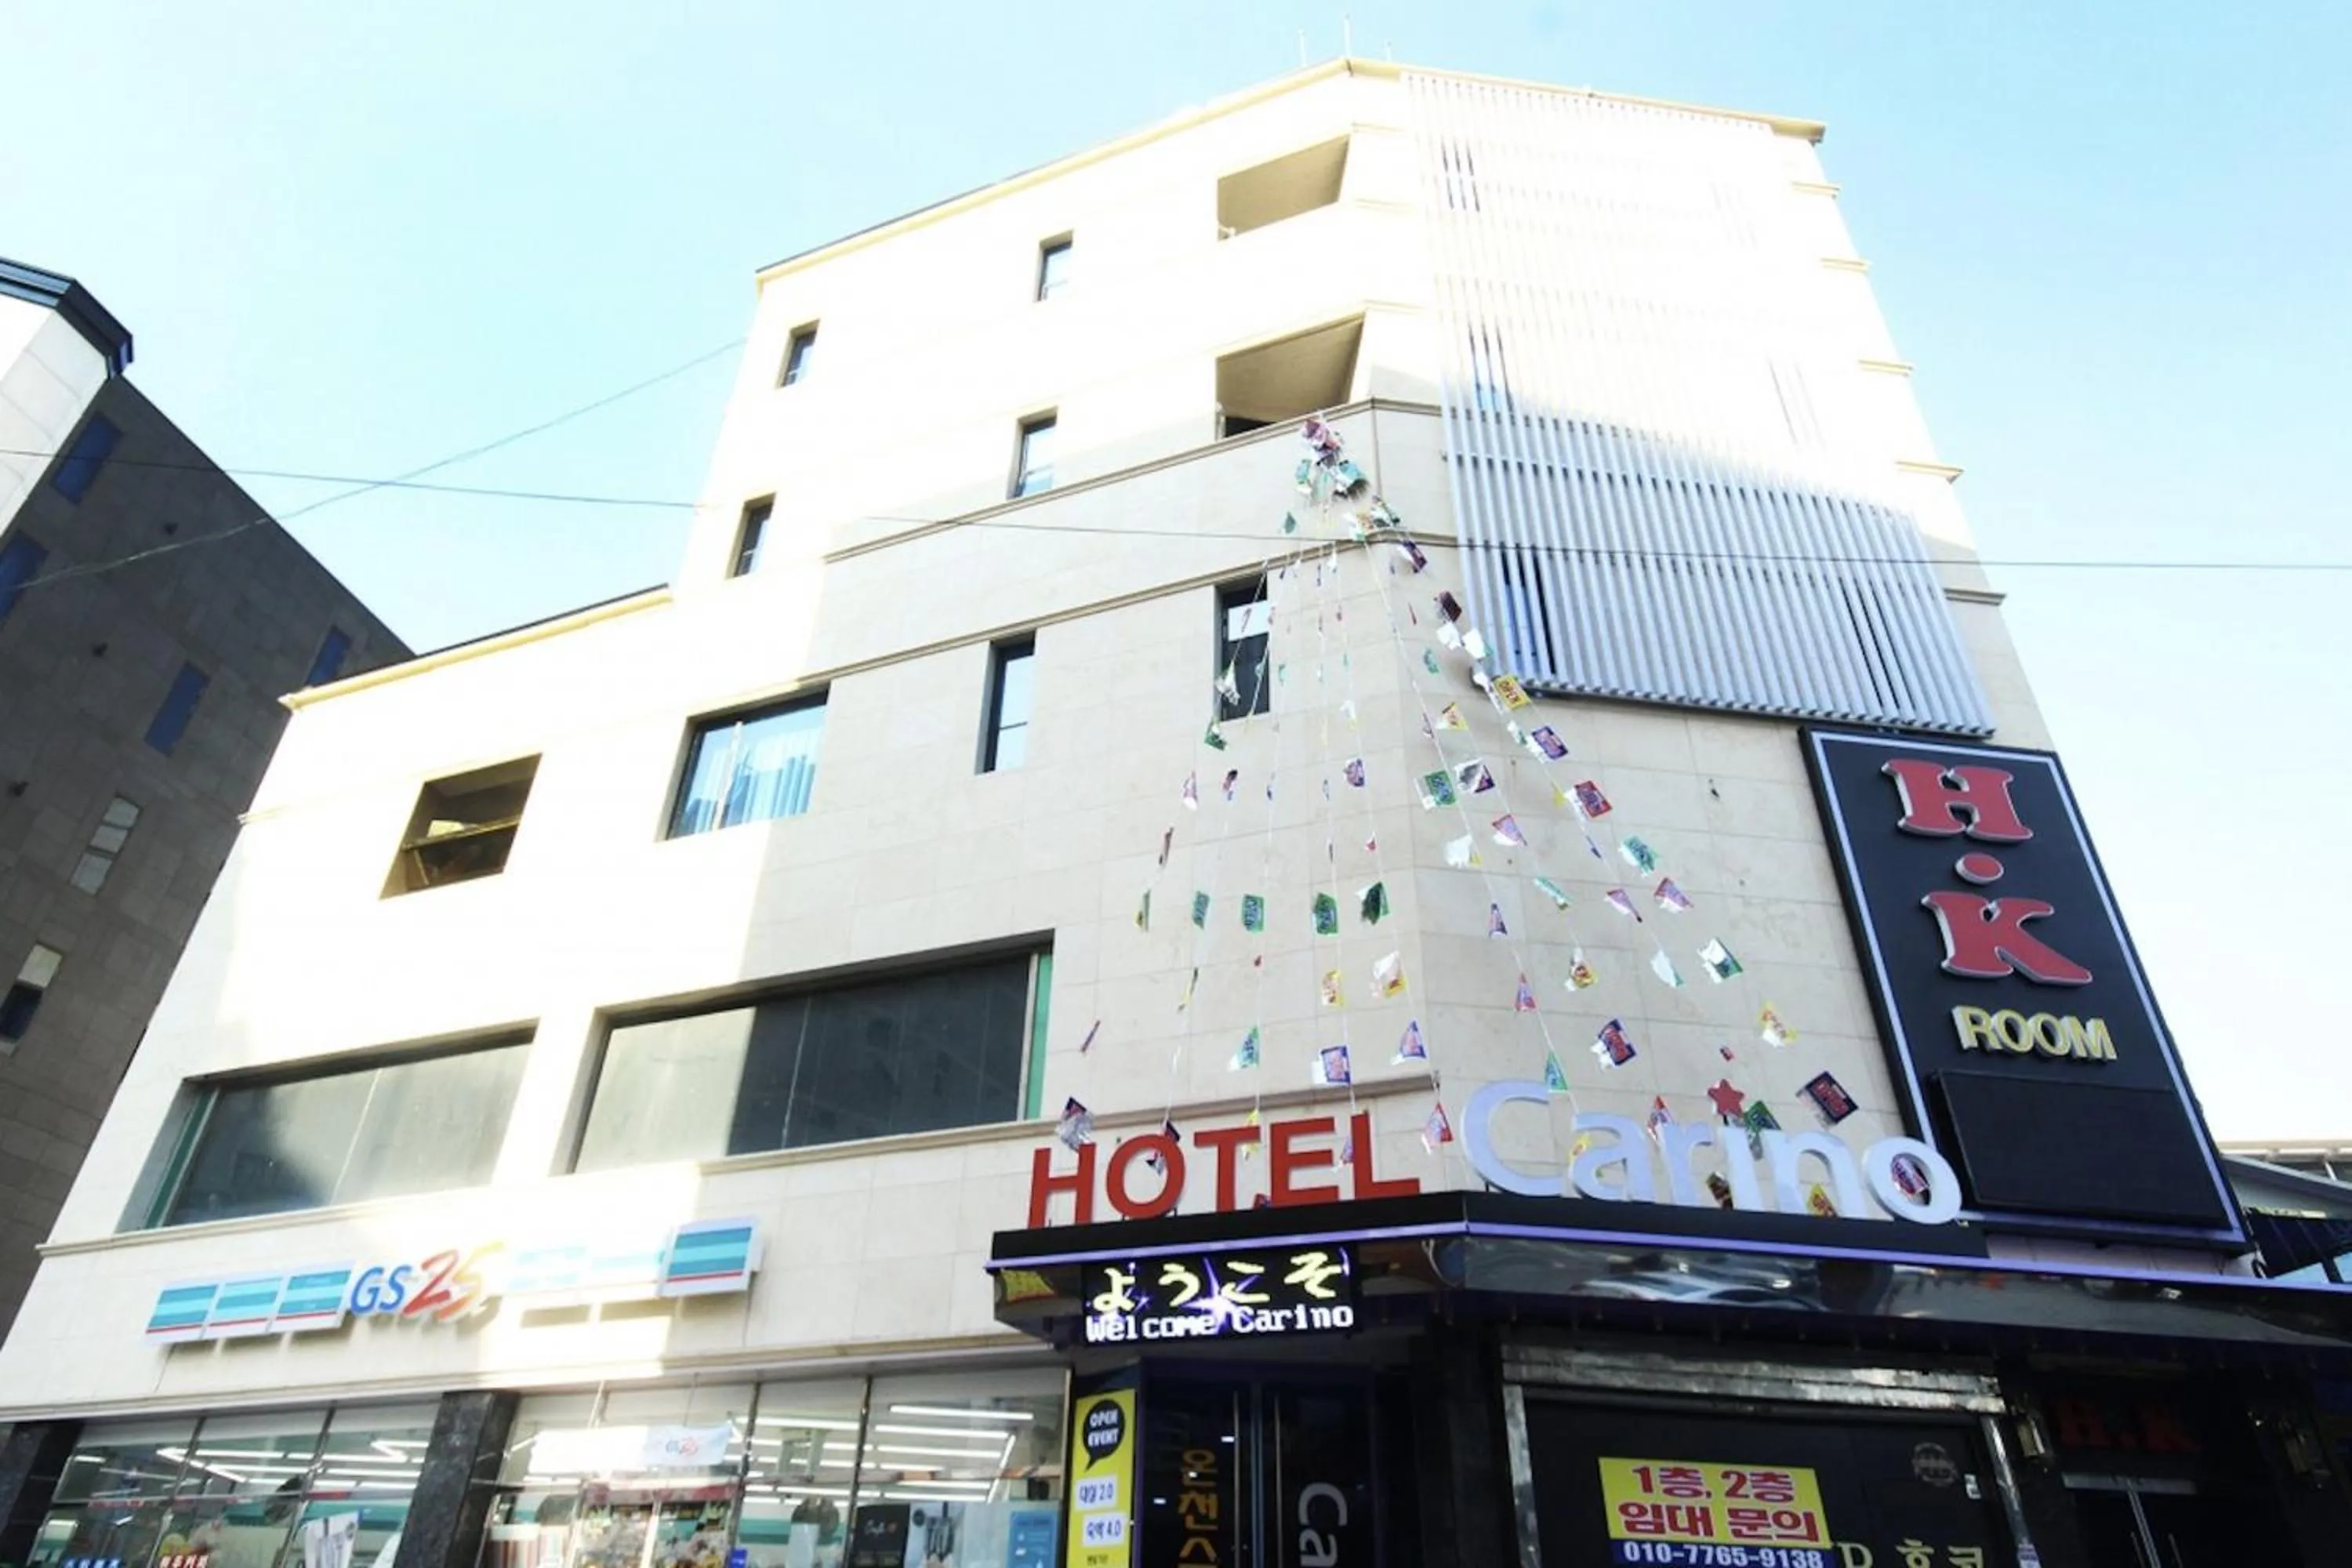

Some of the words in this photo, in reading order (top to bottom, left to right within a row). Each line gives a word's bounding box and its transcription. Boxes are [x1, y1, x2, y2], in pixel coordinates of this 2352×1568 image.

[1951, 1005, 2118, 1062] ROOM
[1028, 1110, 1420, 1229] HOTEL
[1459, 1079, 1962, 1225] Carino
[350, 1240, 504, 1322] GS25
[1092, 1251, 1343, 1314] ようこそ
[1086, 1314, 1216, 1342] Welcome
[1232, 1303, 1354, 1334] Carino
[1087, 1428, 1120, 1447] EVENT
[1089, 1408, 1119, 1428] OPEN
[1720, 1468, 1795, 1504] 2층
[1617, 1500, 1715, 1539] 임대
[1726, 1507, 1820, 1544] 문의
[1622, 1541, 1825, 1568] 010-7765-9138
